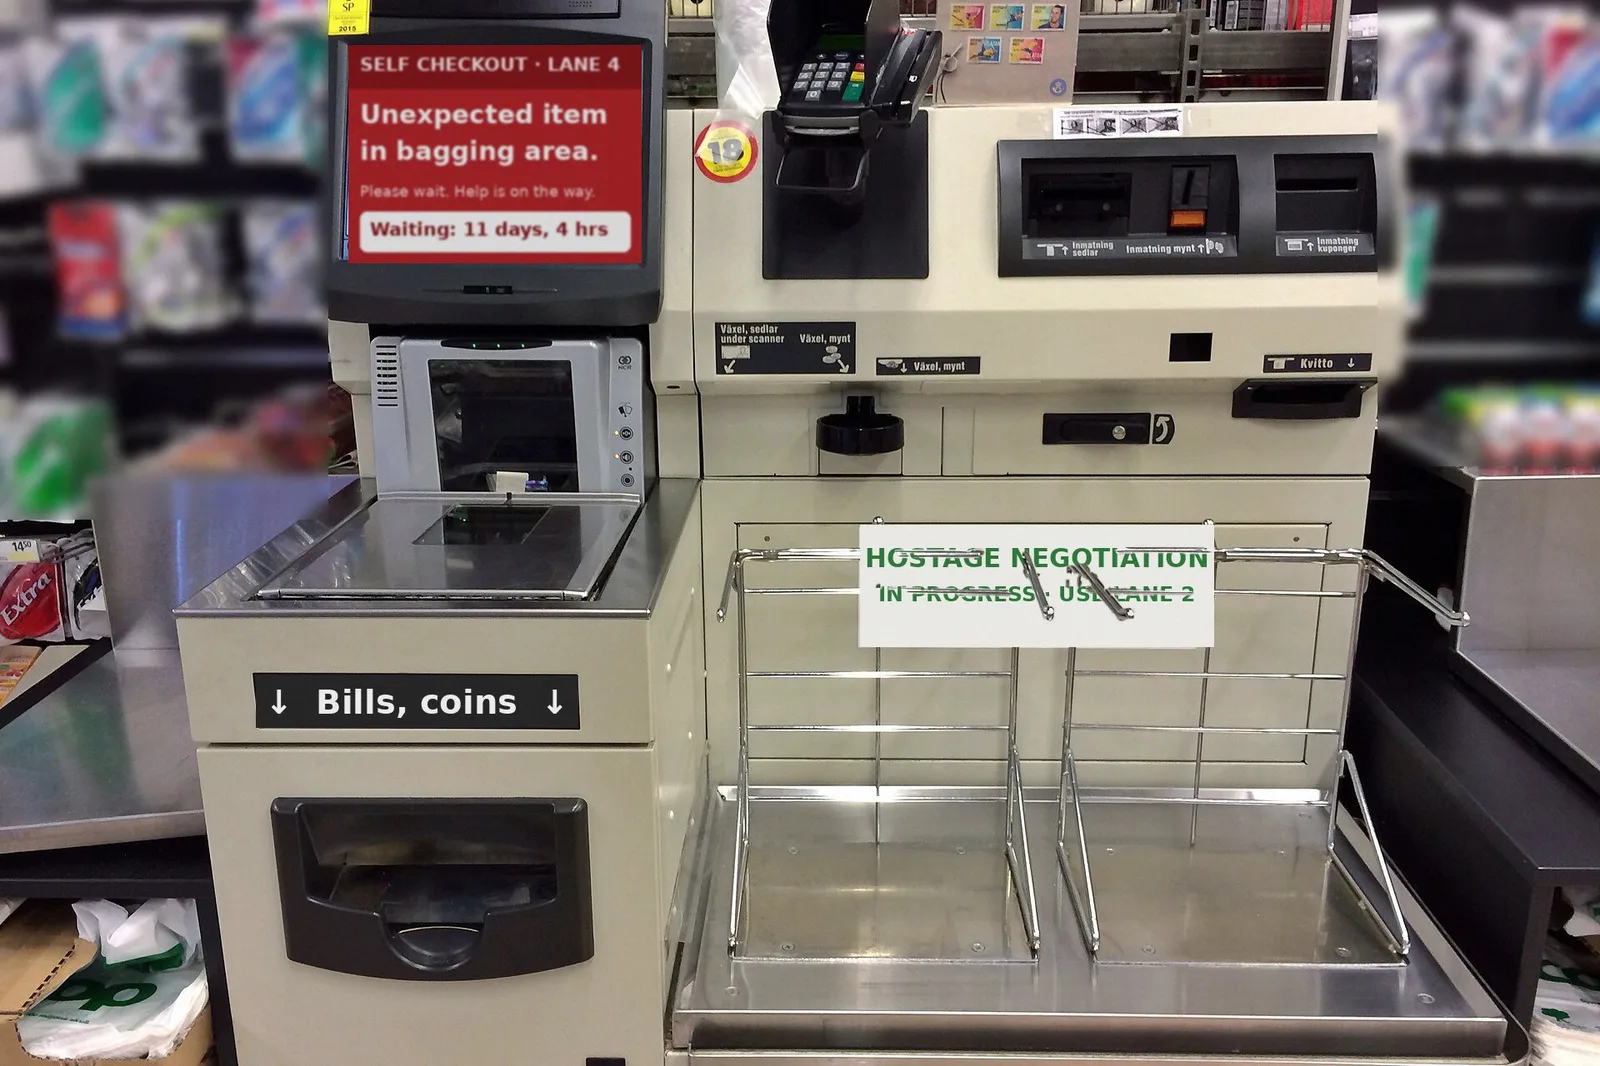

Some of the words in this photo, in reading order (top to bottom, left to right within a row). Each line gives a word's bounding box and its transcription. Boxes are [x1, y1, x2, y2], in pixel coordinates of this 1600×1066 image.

[360, 56, 409, 73] SELF
[417, 56, 527, 73] CHECKOUT
[548, 56, 599, 73] LANE
[607, 56, 621, 73] 4
[361, 102, 533, 130] Unexpected
[543, 102, 608, 125] item
[361, 139, 387, 162] in
[397, 139, 515, 168] bagging
[524, 144, 599, 162] area.
[708, 138, 744, 164] 18
[360, 184, 409, 199] Please
[413, 184, 450, 199] wait.
[455, 184, 490, 201] Help
[494, 184, 506, 199] is
[510, 187, 529, 199] on
[533, 184, 559, 199] the
[563, 187, 595, 202] way.
[370, 221, 455, 241] Waiting:
[465, 221, 489, 238] 11
[494, 221, 549, 241] days,
[556, 221, 569, 238] 4
[575, 221, 609, 238] hrs
[1072, 241, 1114, 250] Inmatning
[1317, 237, 1359, 246] Inmatning
[1317, 244, 1357, 253] kuponger
[1072, 249, 1099, 257] sedlar
[1126, 243, 1172, 254] Inmatning
[1173, 244, 1195, 255] mynt
[720, 324, 748, 335] Växel,
[750, 324, 779, 334] sedlar
[720, 334, 747, 344] under
[748, 334, 785, 344] scanner
[799, 333, 827, 344] Växel,
[829, 334, 851, 345] mynt
[913, 361, 941, 372] Växel,
[943, 361, 966, 373] mynt
[1300, 357, 1334, 369] Kvitto
[866, 547, 1000, 568] HOSTAGE
[0, 572, 52, 626] Extra
[879, 586, 903, 602] IN
[912, 586, 1036, 602] PROGRESS
[1181, 586, 1194, 602] 2
[317, 687, 406, 719] Bills,
[420, 687, 518, 716] coins
